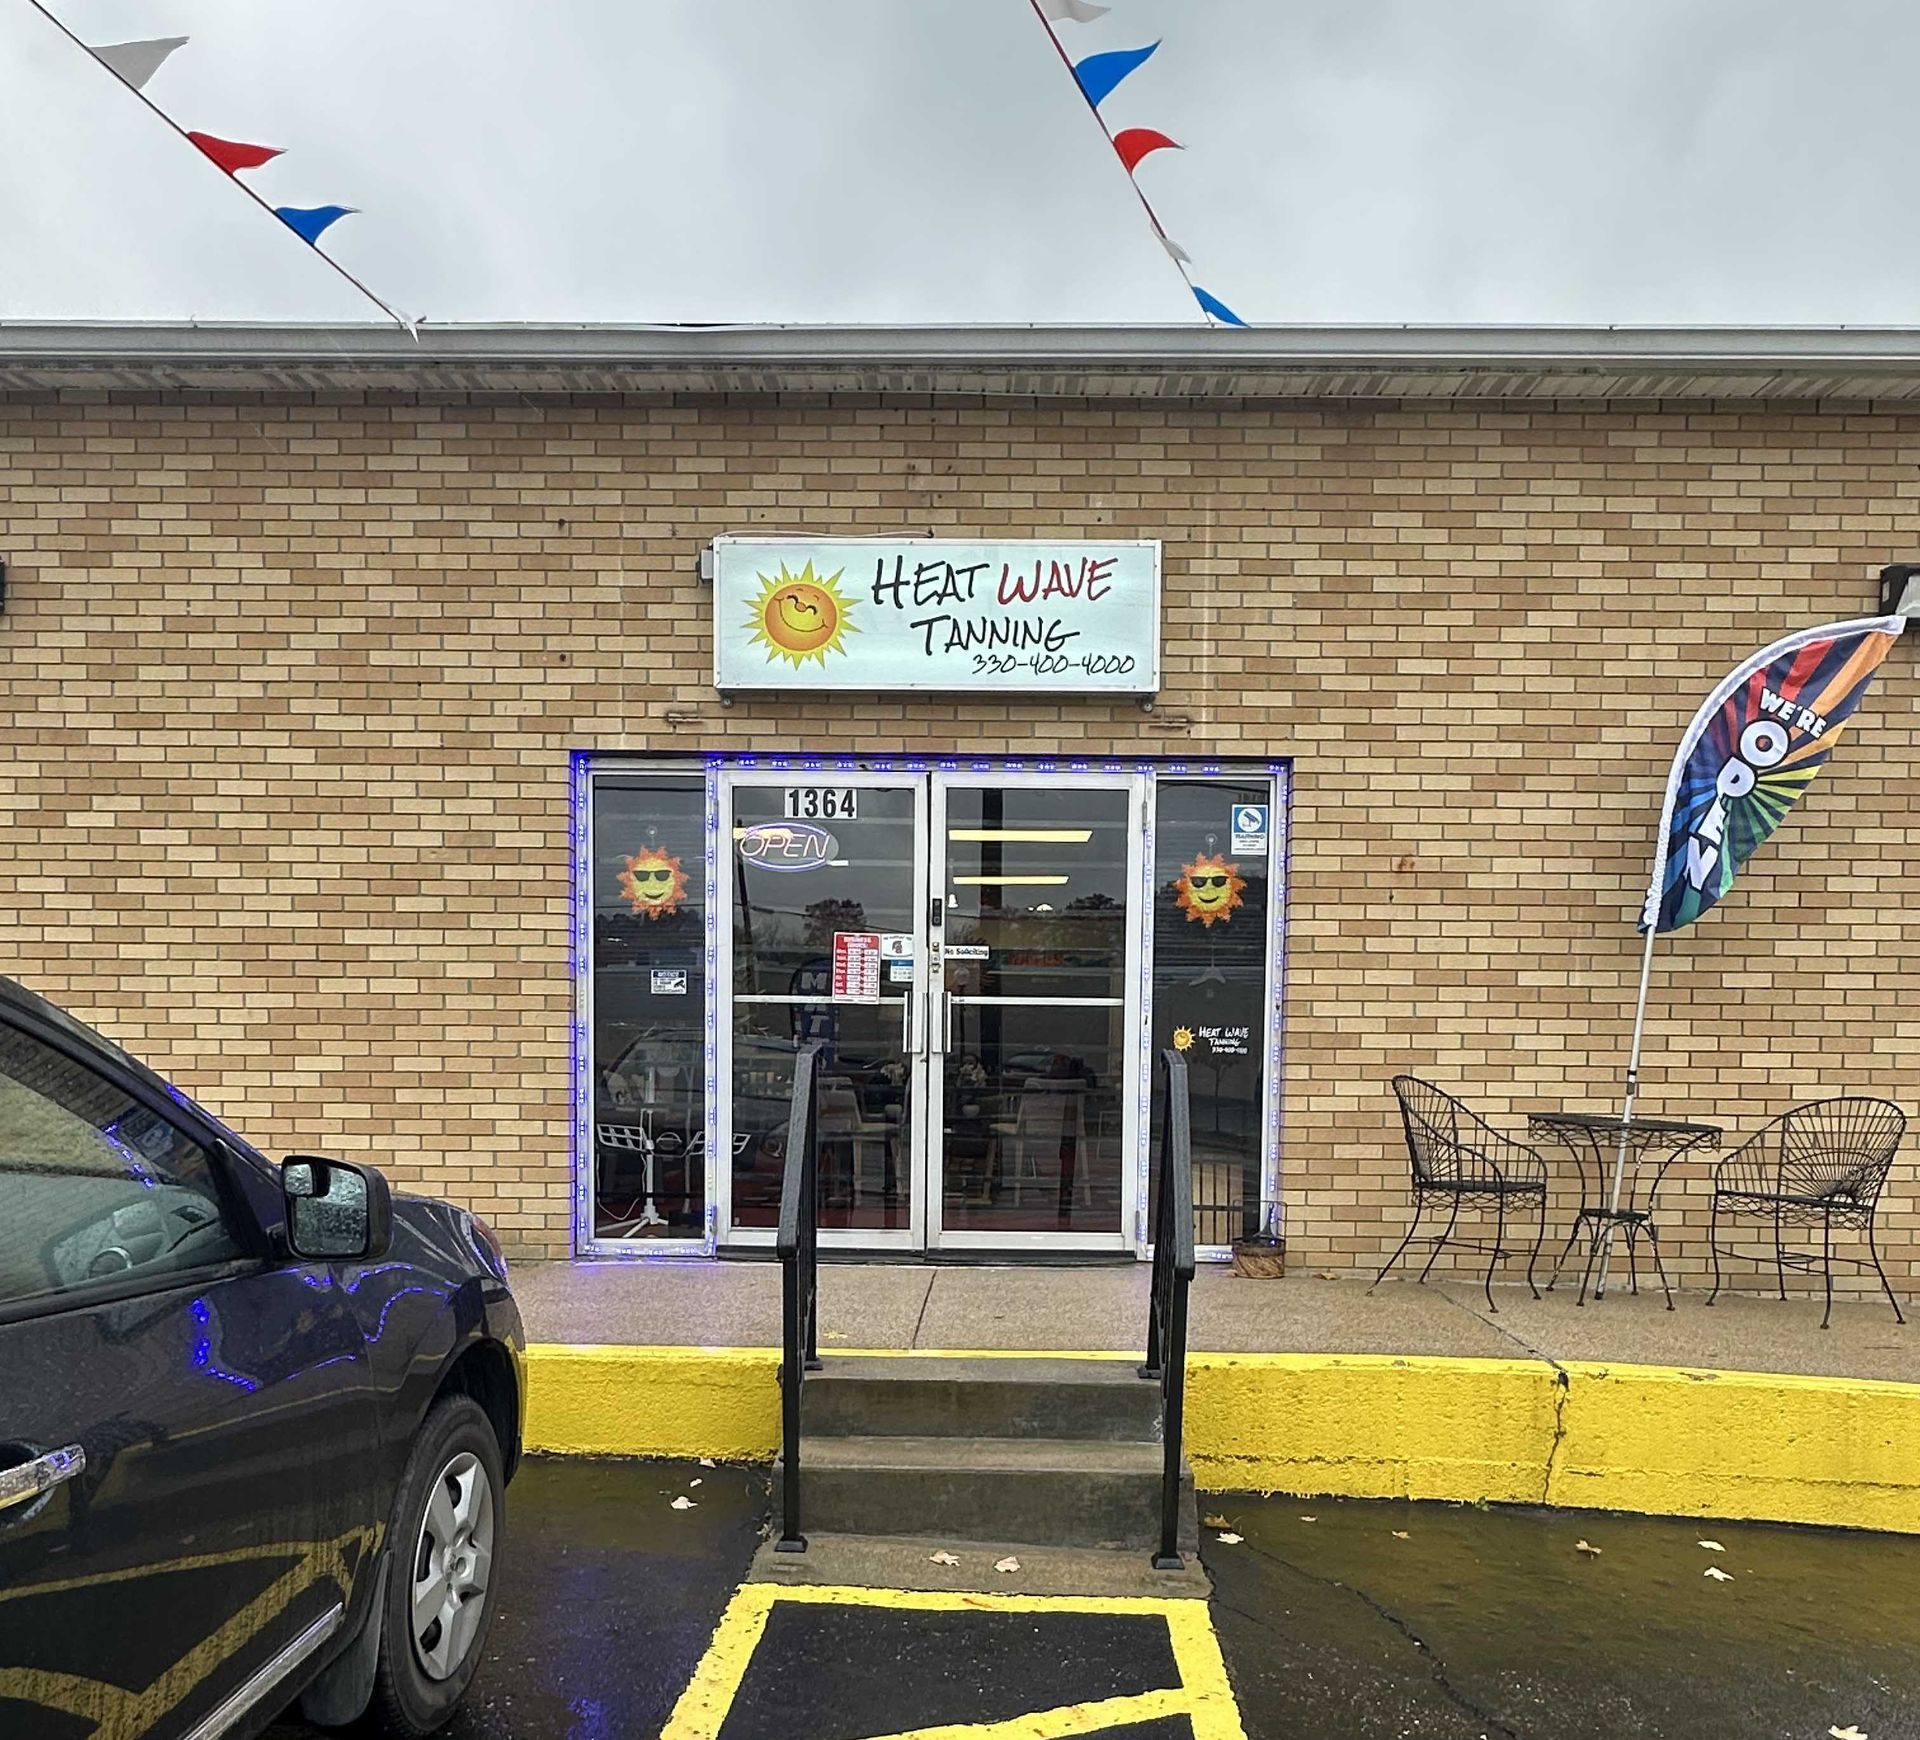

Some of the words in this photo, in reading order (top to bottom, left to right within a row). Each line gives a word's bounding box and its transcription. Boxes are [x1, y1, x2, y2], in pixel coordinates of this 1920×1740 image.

[871, 555, 990, 609] HEAT
[996, 557, 1118, 605] WAVE
[910, 615, 1080, 655] TANNING
[972, 654, 1135, 675] 330-400-4000
[1760, 688, 1827, 739] WE'RE
[788, 789, 855, 818] 1364
[740, 833, 830, 858] OPEN
[944, 947, 954, 955] No
[1198, 1025, 1222, 1038] HEAT
[1225, 1026, 1250, 1039] WAVE
